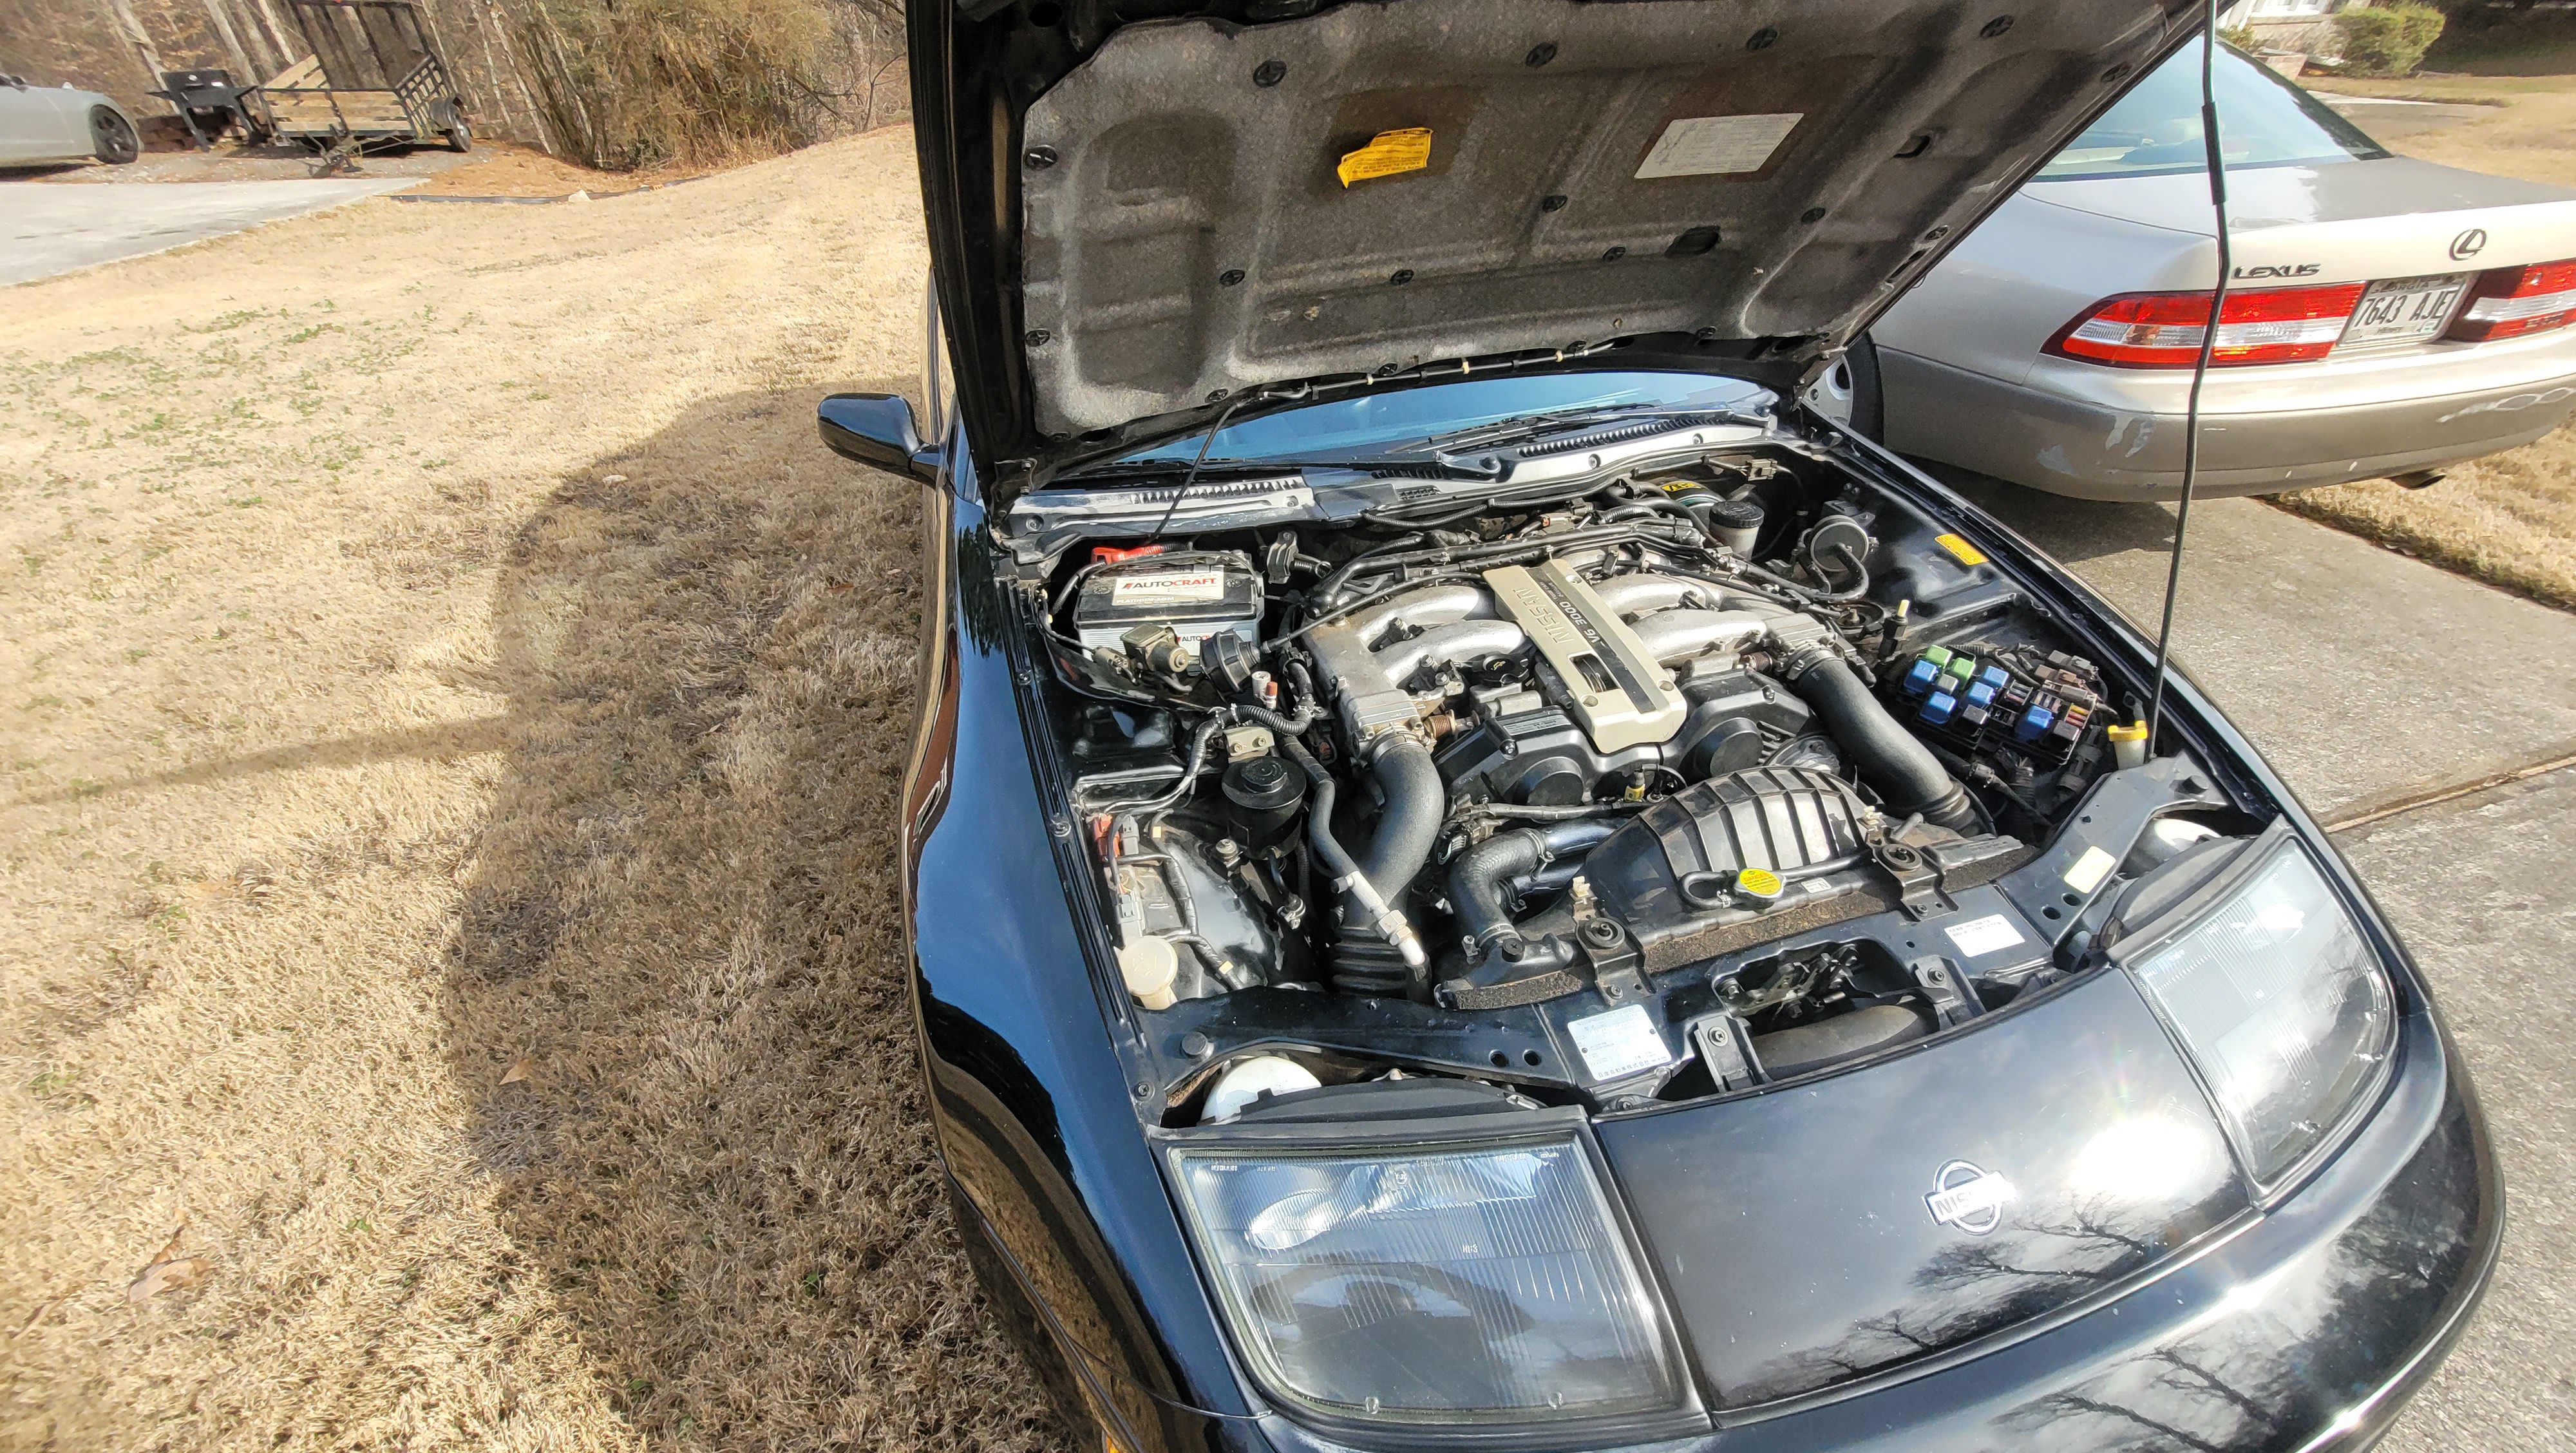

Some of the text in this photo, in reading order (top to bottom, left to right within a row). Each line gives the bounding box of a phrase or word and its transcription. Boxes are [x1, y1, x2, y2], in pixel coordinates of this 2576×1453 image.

[2231, 261, 2321, 280] LEXUS
[2354, 289, 2460, 328] 7643 AJE
[1132, 578, 1217, 589] AUTOCRAFT
[1513, 588, 1575, 643] NISSAN
[1558, 601, 1602, 643] V6 3000
